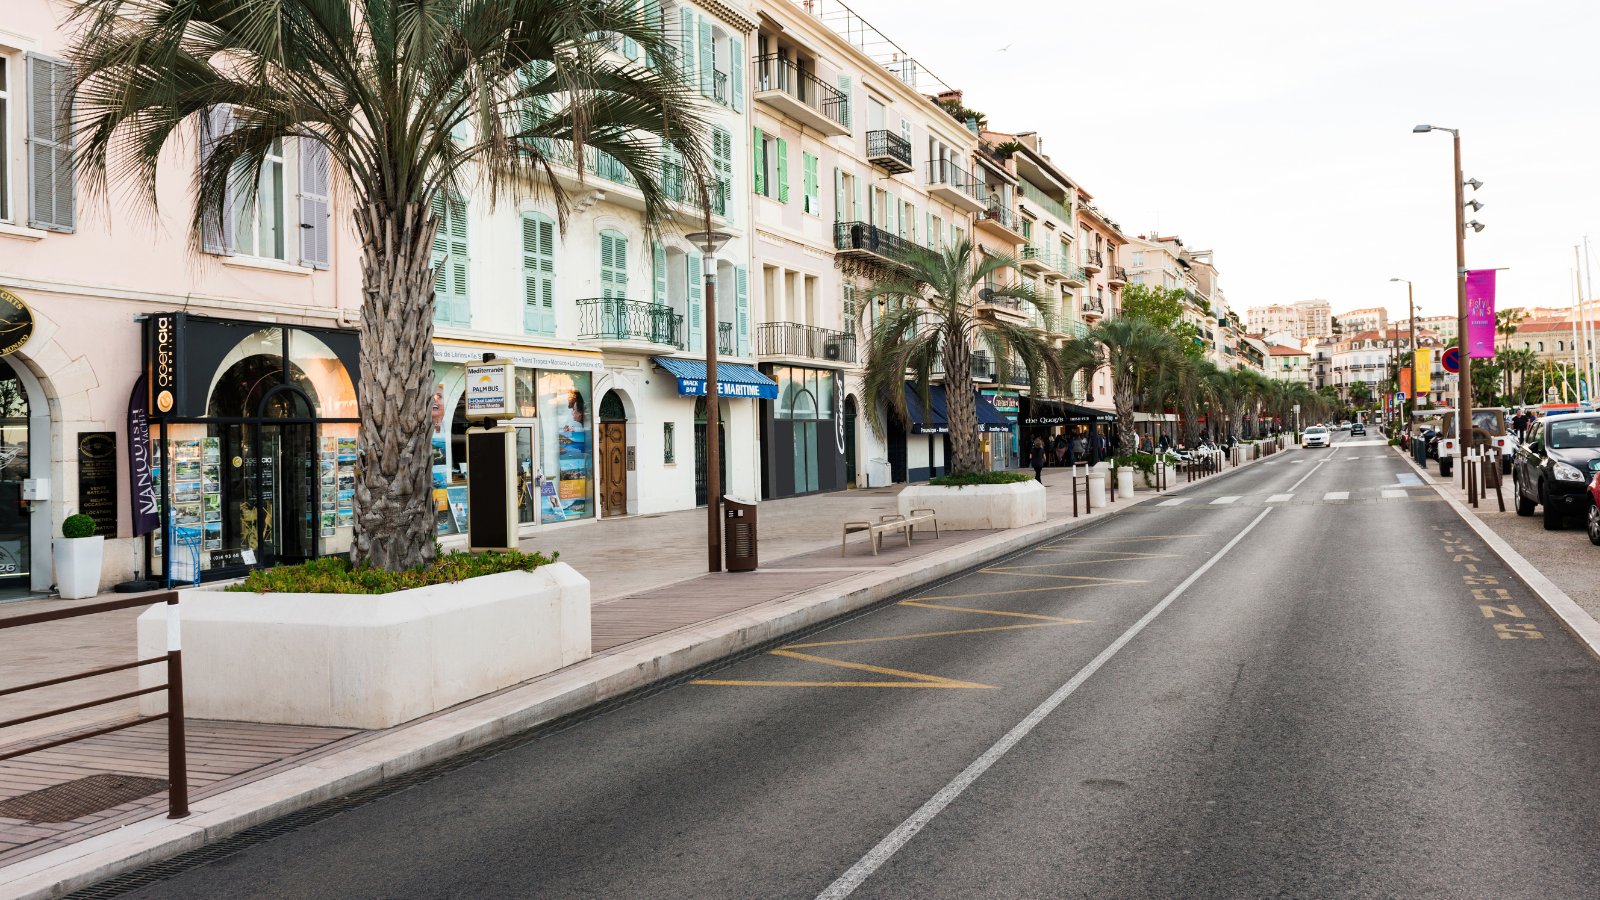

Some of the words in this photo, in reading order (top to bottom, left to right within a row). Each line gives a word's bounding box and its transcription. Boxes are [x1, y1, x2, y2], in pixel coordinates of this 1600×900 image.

[0, 291, 24, 310] CHTS
[1, 334, 29, 354] MONACO
[158, 317, 168, 387] agencia
[723, 383, 760, 396] MARITIME
[132, 409, 158, 515] VANQUISH
